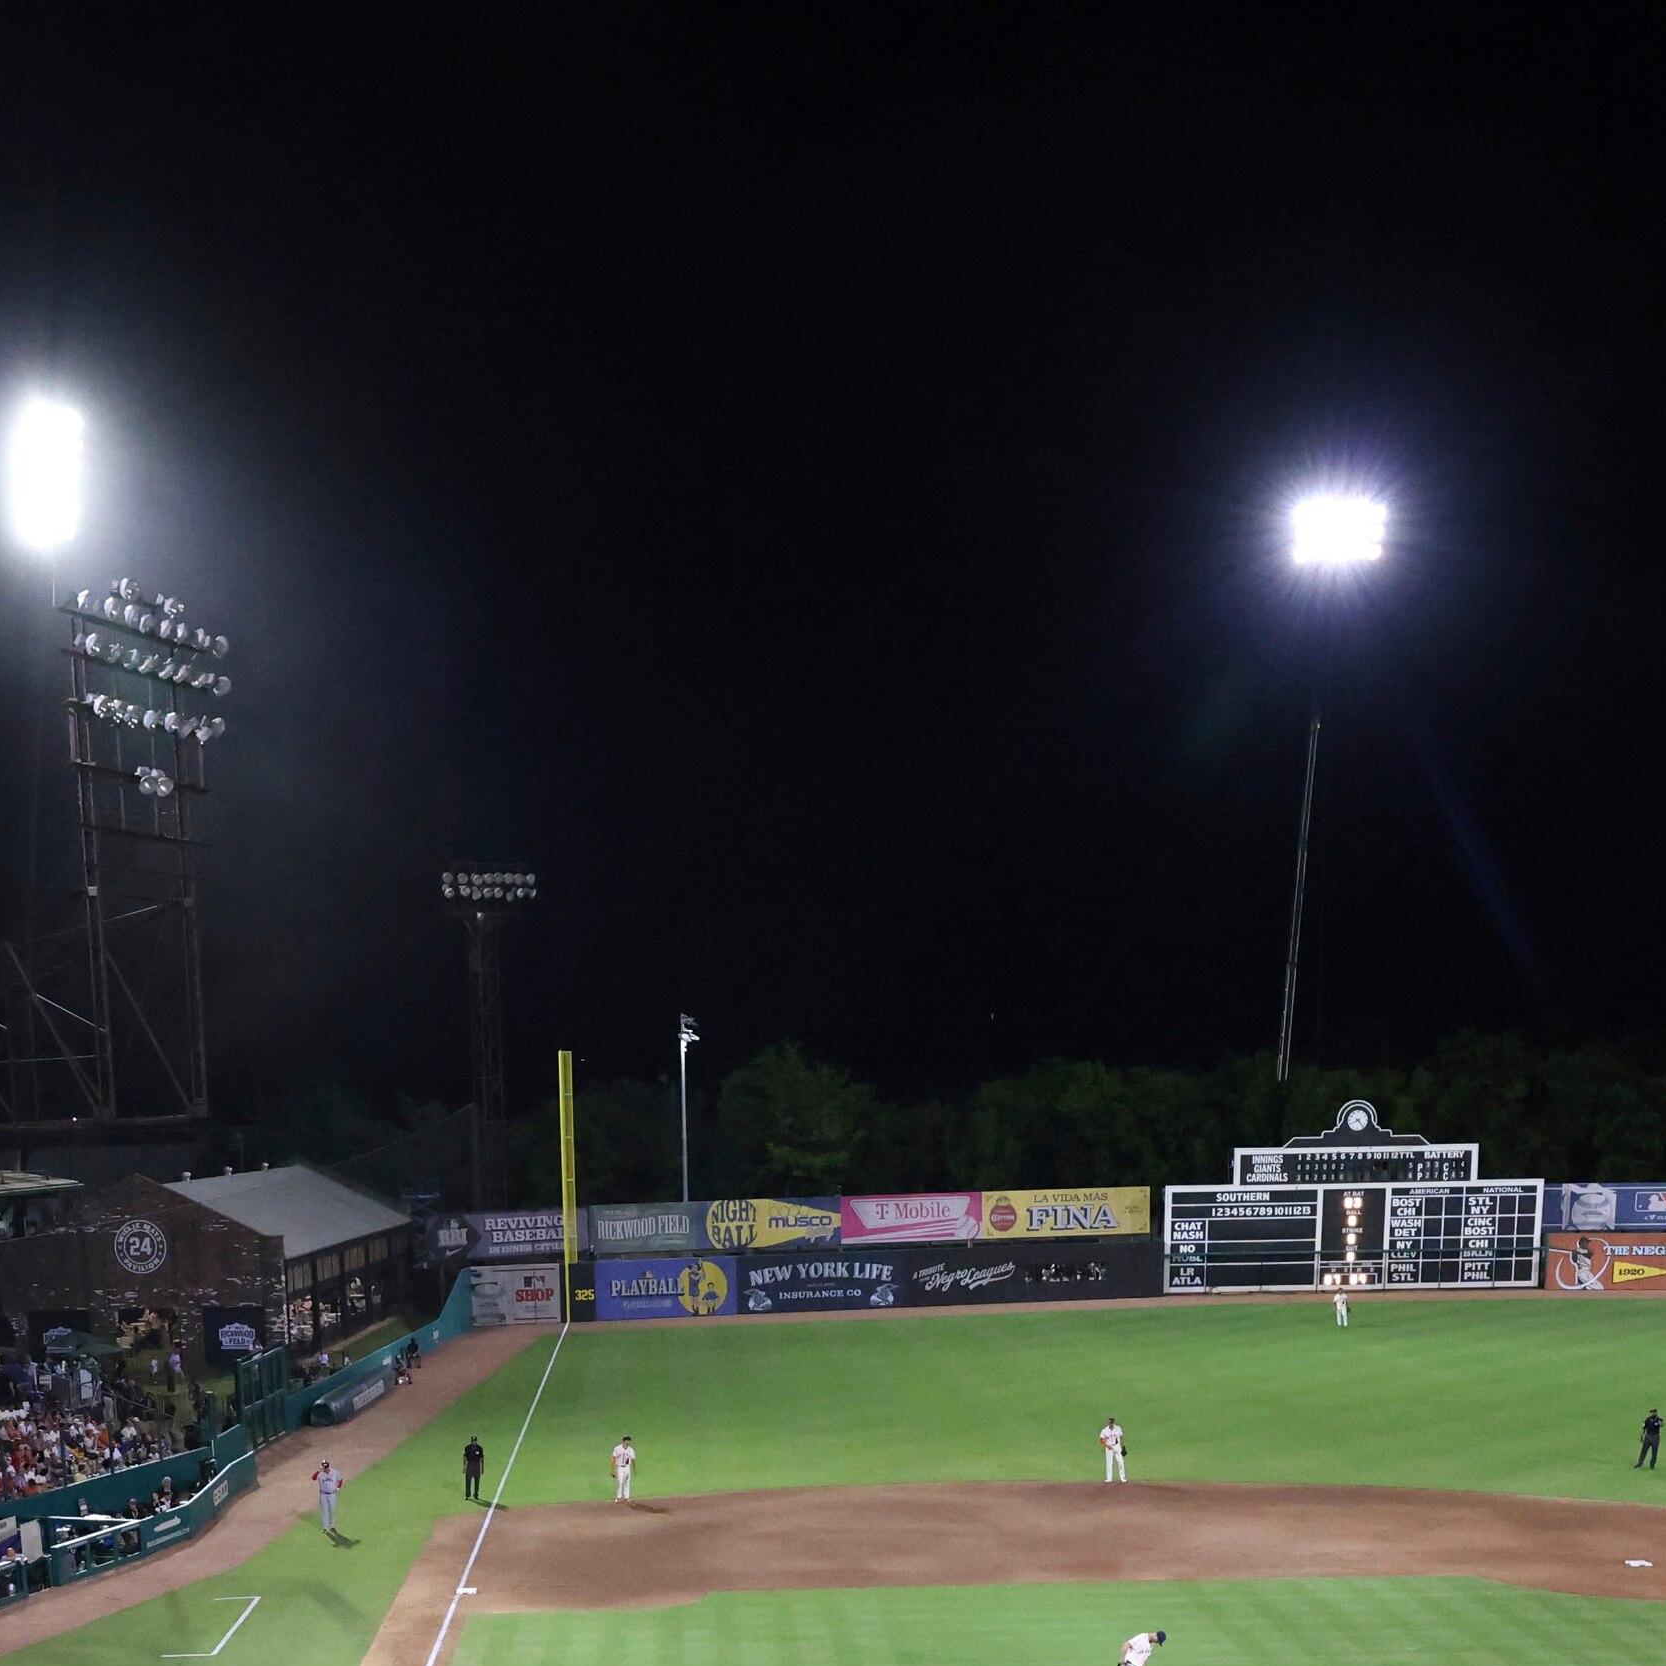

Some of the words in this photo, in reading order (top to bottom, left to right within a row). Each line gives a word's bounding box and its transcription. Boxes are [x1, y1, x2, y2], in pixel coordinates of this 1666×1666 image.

[1252, 1154, 1284, 1165] INNINGS
[1306, 1153, 1312, 1161] 2
[1315, 1153, 1320, 1161] 3
[1322, 1153, 1328, 1161] 4
[1340, 1152, 1346, 1160] 6
[1349, 1152, 1354, 1160] 7
[1357, 1152, 1363, 1160] 8
[1366, 1152, 1372, 1160] 9
[1424, 1150, 1465, 1159] BATTERY
[1254, 1163, 1281, 1173] GIANTS
[1246, 1173, 1288, 1183] CARDINALS
[1034, 1194, 1049, 1203] LA
[1052, 1193, 1081, 1203] VIDA
[1216, 1192, 1270, 1202] SOUTHERN
[1468, 1197, 1493, 1205] STL
[1392, 1199, 1421, 1207] BOST
[711, 1200, 758, 1225] NIGHT
[1397, 1208, 1415, 1216] CHI
[1471, 1206, 1490, 1215] NY
[1027, 1204, 1119, 1232] FINA
[1467, 1218, 1492, 1226] CINC
[485, 1215, 564, 1231] REVIVING
[598, 1216, 655, 1240] RICKWOOD
[658, 1215, 690, 1235] FIELD
[1174, 1222, 1203, 1231] CHAT
[1391, 1219, 1421, 1228] WASH
[492, 1228, 564, 1243] BASEBAL
[712, 1222, 759, 1248] BALL
[1173, 1231, 1203, 1240] NASH
[1394, 1228, 1417, 1237] DET
[1464, 1227, 1495, 1235] BOST
[129, 1237, 152, 1256] 24
[1396, 1241, 1413, 1249] NY
[1468, 1239, 1488, 1248] CHI
[1179, 1245, 1195, 1253] NO
[1604, 1246, 1630, 1256] THE
[919, 1263, 946, 1277] TRIBUTE
[1390, 1263, 1416, 1272] PHIL
[1464, 1262, 1491, 1270] PITT
[749, 1264, 793, 1286] NEW
[796, 1262, 849, 1279] YORK
[852, 1262, 893, 1281] LIFE
[1180, 1267, 1194, 1276] LR
[1464, 1271, 1490, 1280] PHIL
[1618, 1268, 1645, 1276] 1920
[925, 1269, 968, 1292] Negro
[960, 1261, 1015, 1289] Leagues
[1172, 1277, 1201, 1285] ATLA
[1392, 1272, 1414, 1281] STL
[611, 1277, 684, 1297] PLAYBALL
[516, 1288, 554, 1302] SHOP
[575, 1289, 595, 1301] 325
[779, 1290, 844, 1299] INSURANCE
